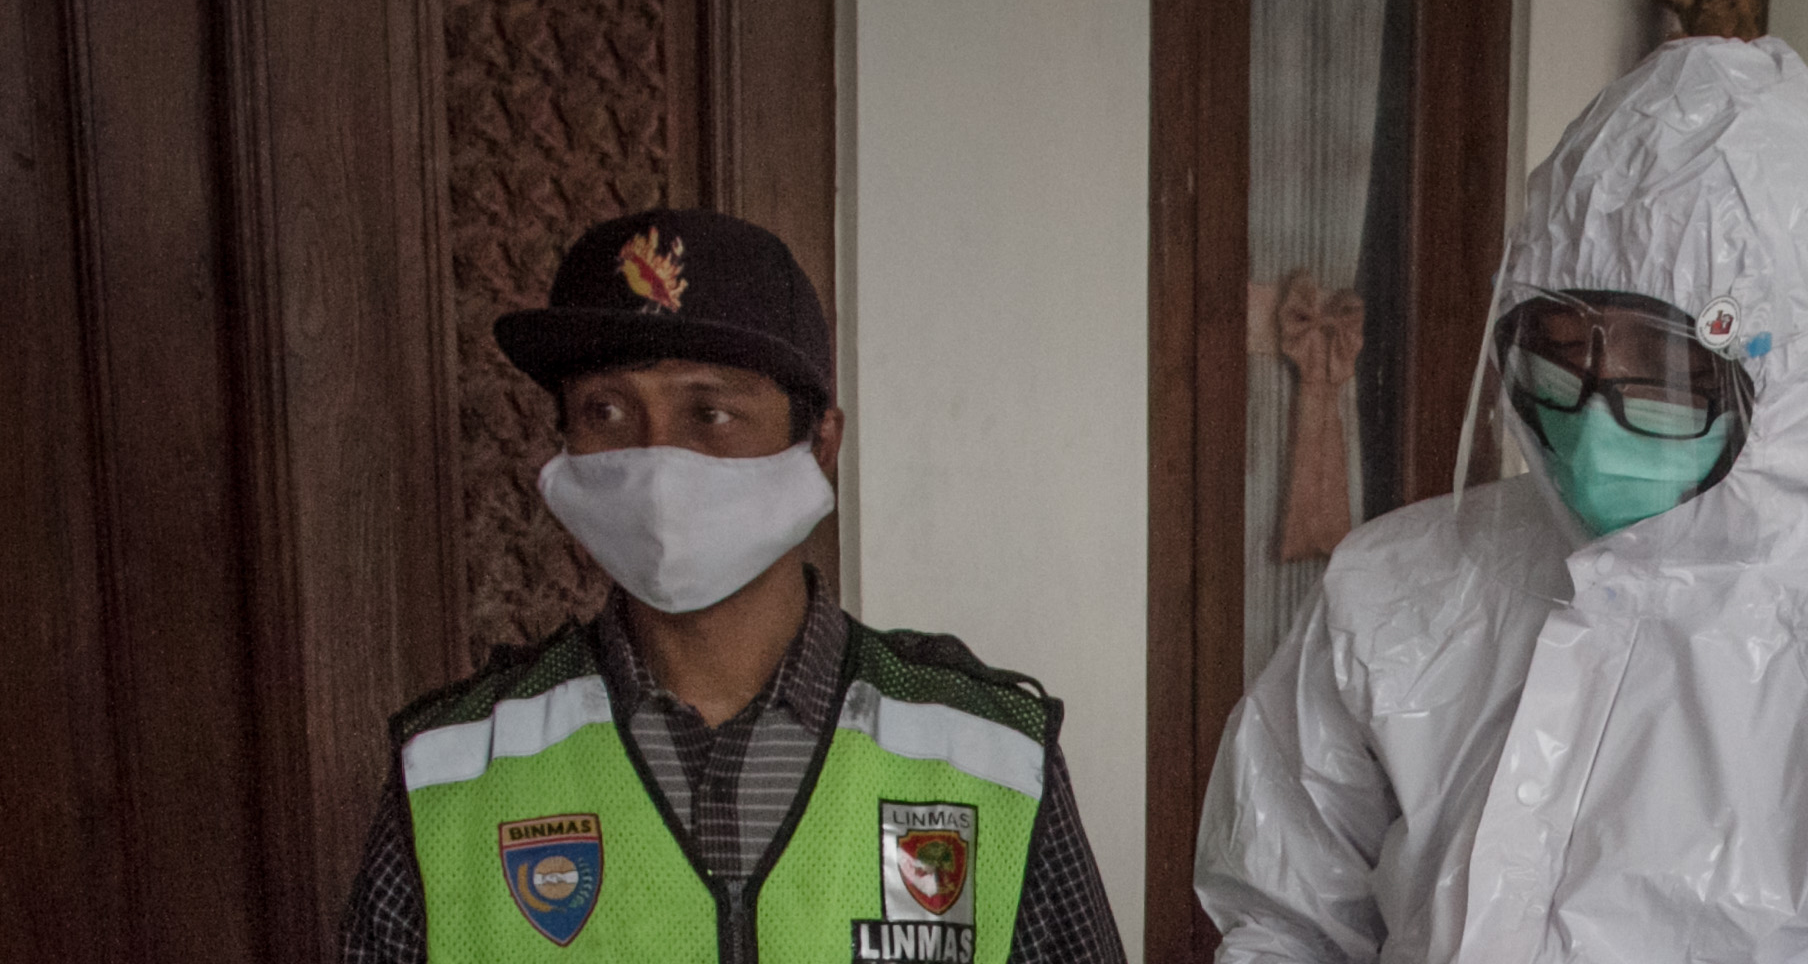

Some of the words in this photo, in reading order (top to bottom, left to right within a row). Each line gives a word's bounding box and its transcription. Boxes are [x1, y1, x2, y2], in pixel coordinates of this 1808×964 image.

[508, 818, 593, 842] BINMAS
[892, 808, 971, 829] LINMAS
[858, 923, 973, 963] LINMAS
